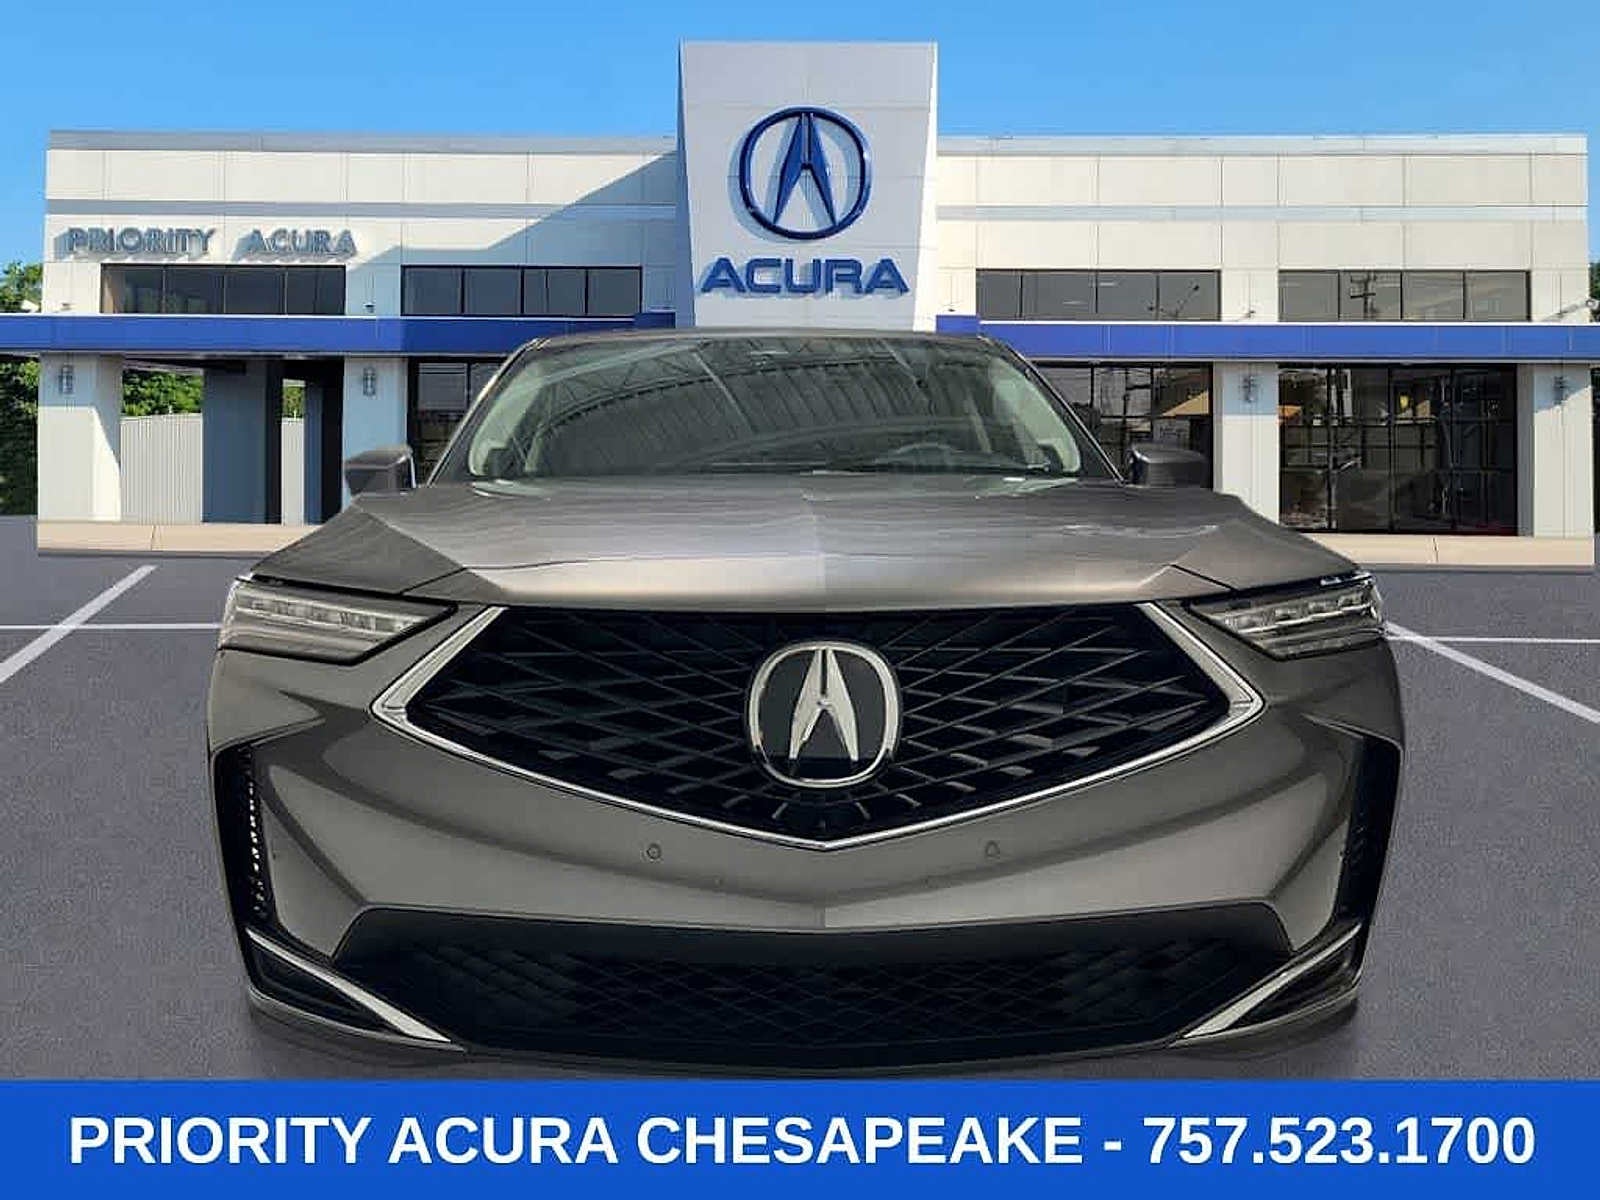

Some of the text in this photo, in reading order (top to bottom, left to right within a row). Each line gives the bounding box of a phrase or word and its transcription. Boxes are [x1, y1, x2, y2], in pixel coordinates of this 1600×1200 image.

[66, 227, 357, 256] PRIORITY ACURA
[701, 257, 910, 295] ACURA
